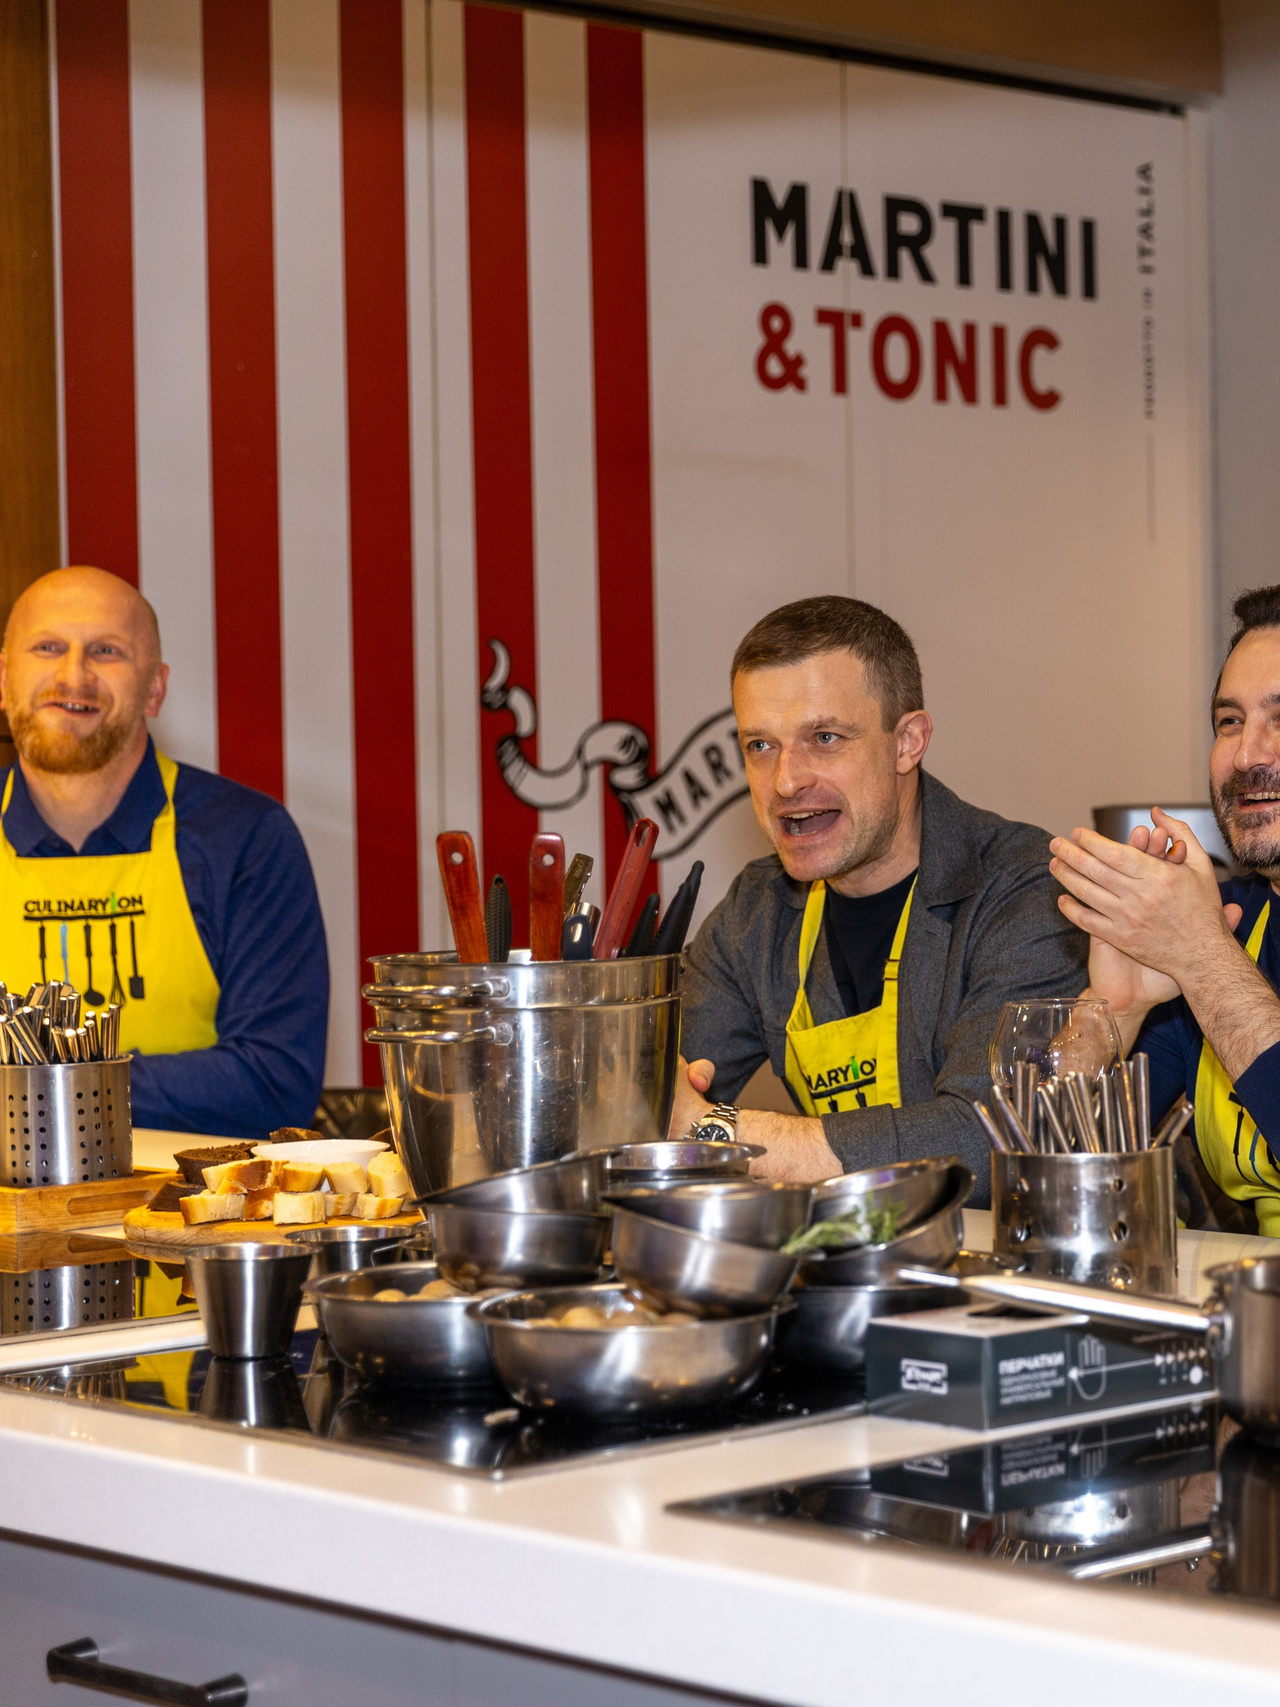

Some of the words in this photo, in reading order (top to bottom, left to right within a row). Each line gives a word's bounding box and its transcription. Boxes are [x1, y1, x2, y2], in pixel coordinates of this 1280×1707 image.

[751, 176, 1097, 302] MARTINI
[1136, 162, 1156, 275] ITALIA
[999, 1351, 1065, 1375] ПЕРЧАТКИ
